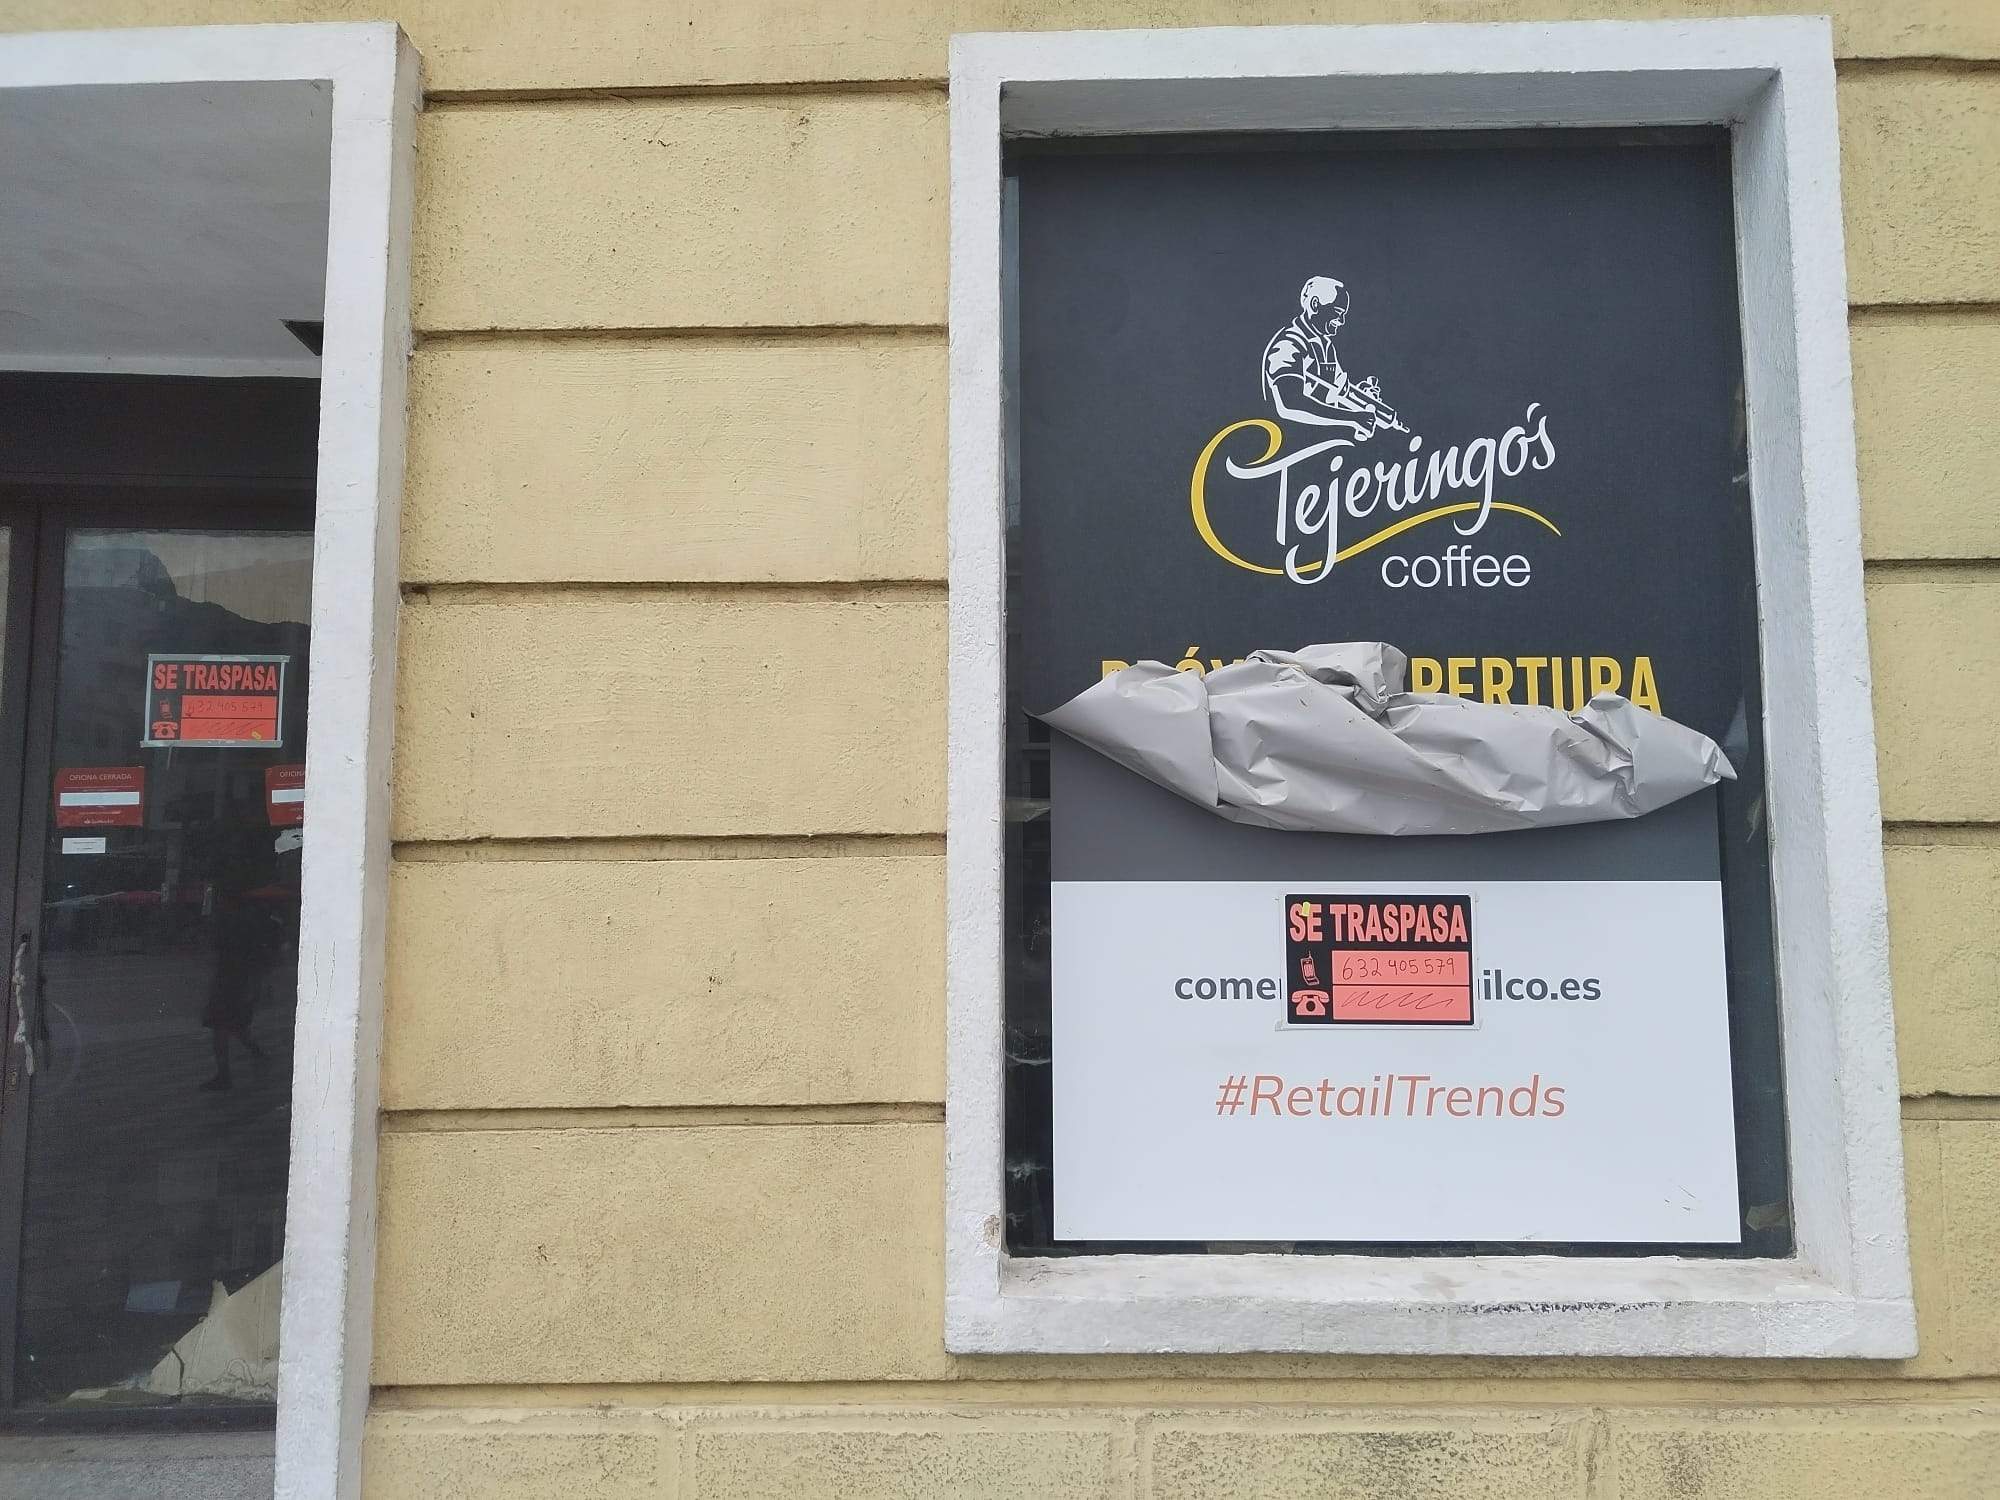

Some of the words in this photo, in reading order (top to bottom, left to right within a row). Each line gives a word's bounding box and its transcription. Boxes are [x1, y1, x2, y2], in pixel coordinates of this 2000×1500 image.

[1381, 545, 1531, 588] coffee
[153, 664, 178, 690] SE
[182, 664, 278, 691] TRASPASA
[1411, 656, 1662, 717] PERTURA
[1289, 903, 1323, 943] SE
[1330, 903, 1468, 943] TRASPASA
[1342, 957, 1382, 981] 632
[1388, 957, 1419, 976] 405
[1425, 957, 1455, 976] 579
[1215, 1074, 1567, 1117] #RetailTrends
